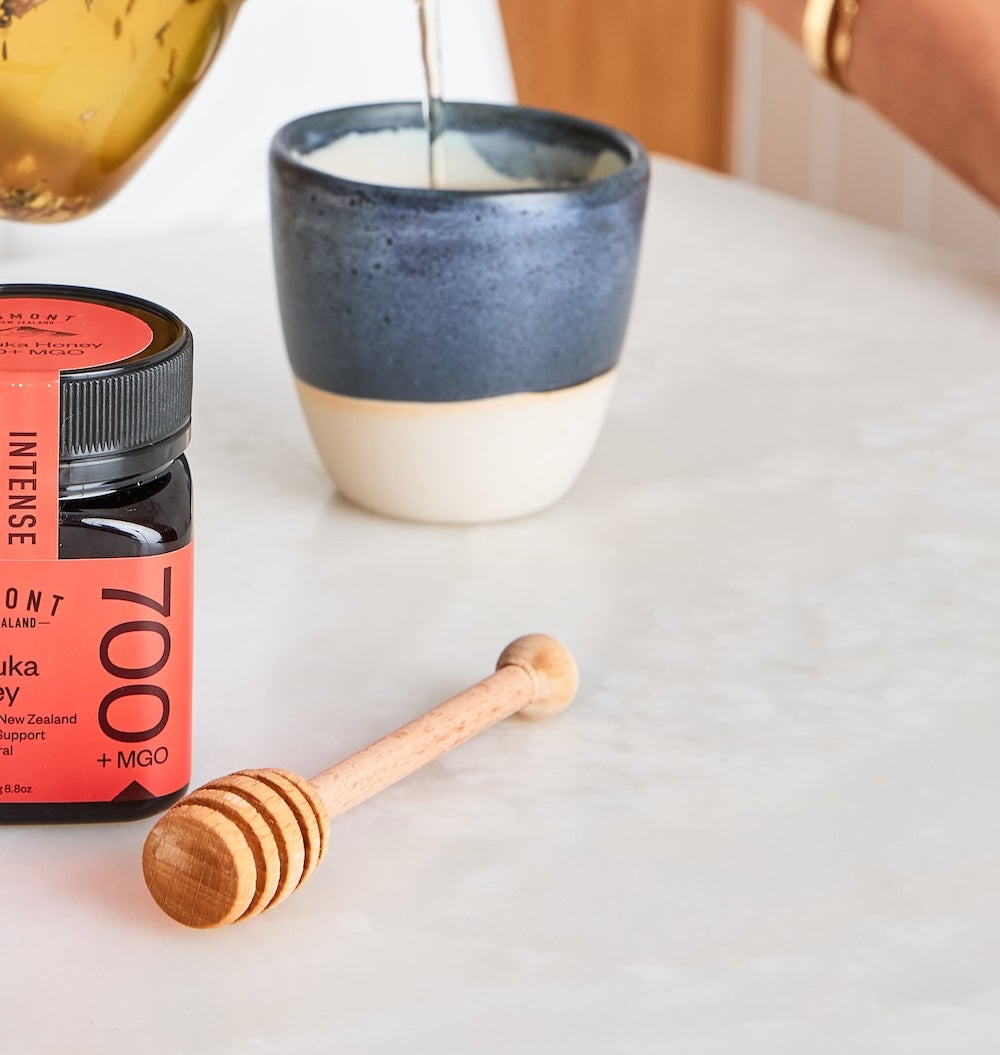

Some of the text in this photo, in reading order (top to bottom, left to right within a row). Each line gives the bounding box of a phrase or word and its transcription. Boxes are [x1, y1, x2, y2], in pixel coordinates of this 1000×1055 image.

[8, 431, 37, 546] INTENSE
[98, 566, 172, 743] 700
[27, 713, 77, 725] Zealand
[117, 746, 169, 769] MGO
[4, 784, 32, 794] 8.8oz
